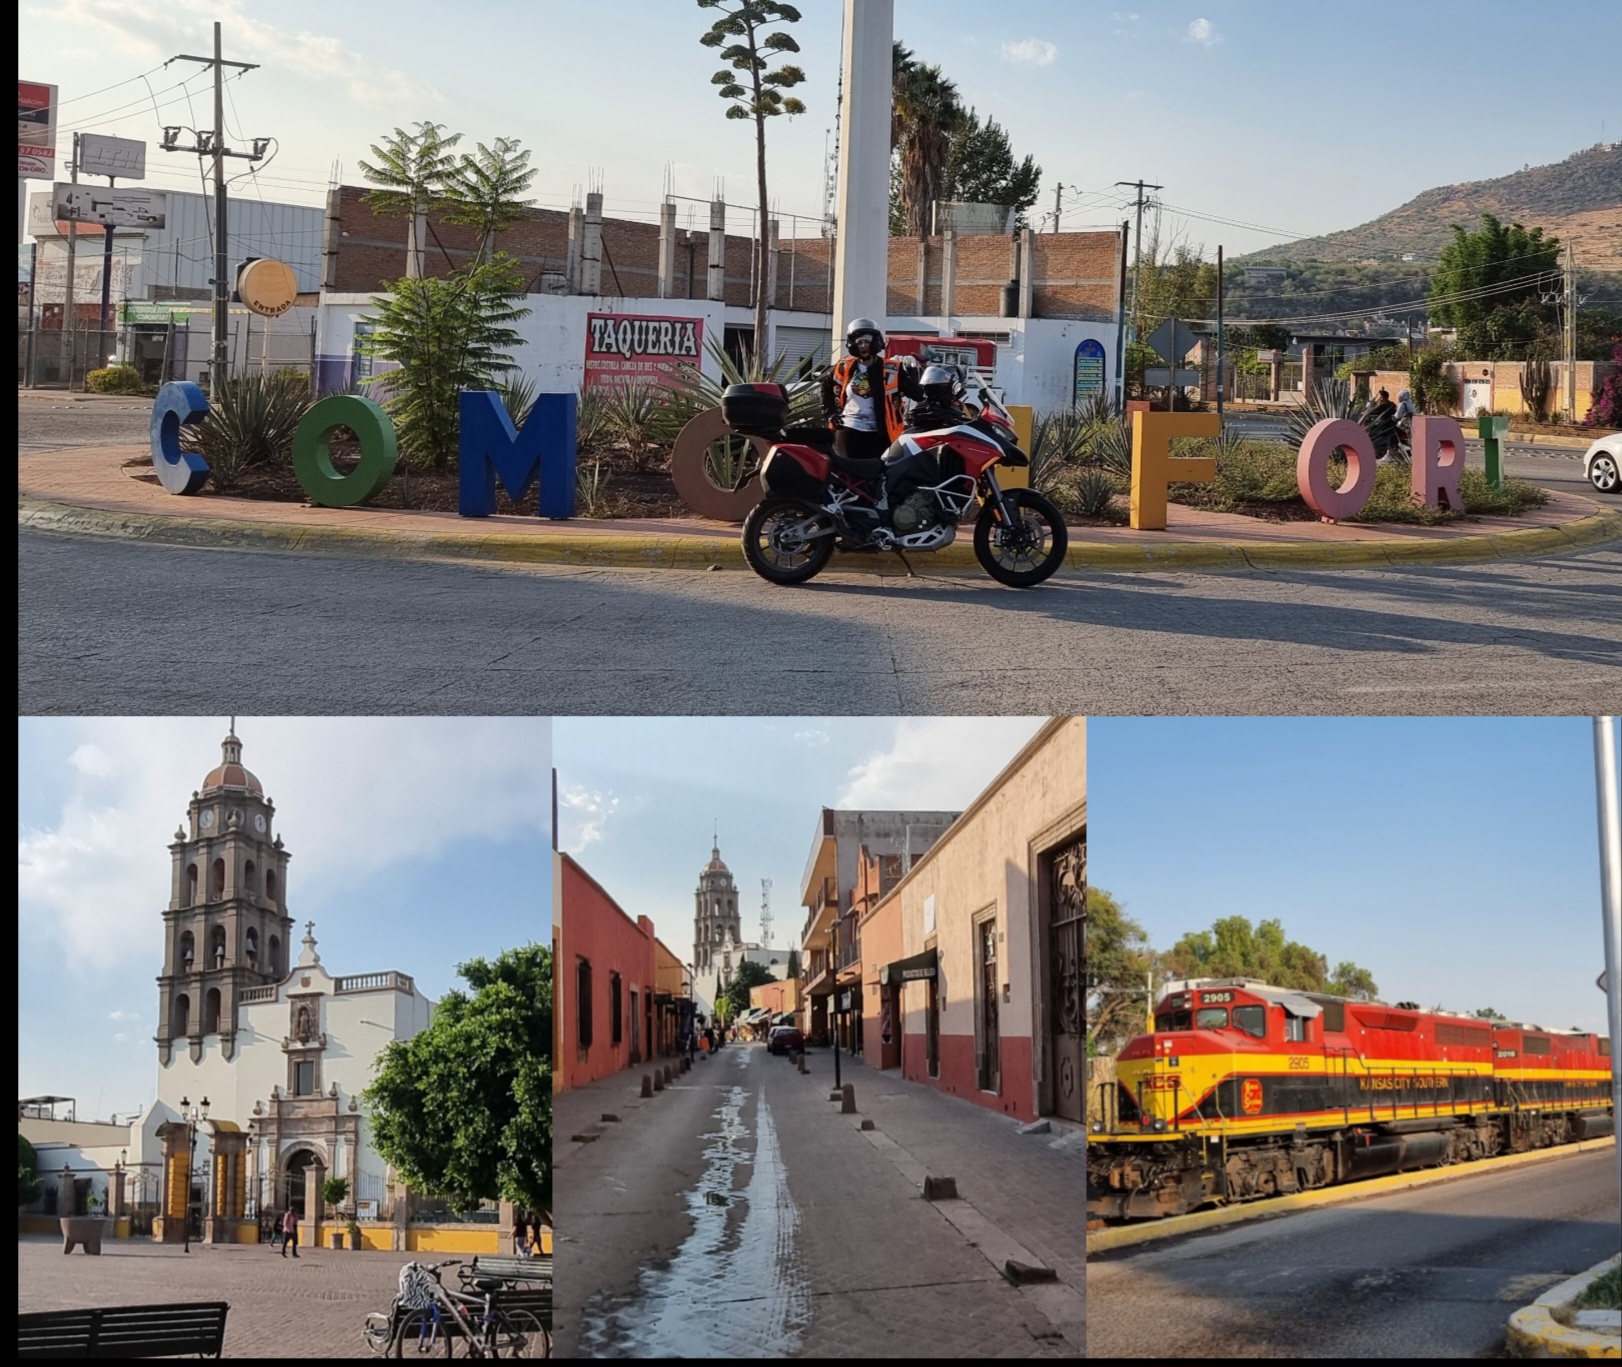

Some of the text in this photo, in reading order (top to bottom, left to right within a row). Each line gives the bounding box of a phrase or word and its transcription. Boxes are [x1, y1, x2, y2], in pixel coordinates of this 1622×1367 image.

[253, 300, 291, 314] ENTRADA
[590, 318, 697, 359] TAQUERIA
[1203, 992, 1231, 1004] 2905
[1288, 1056, 1310, 1070] 2905
[1144, 1075, 1182, 1090] KCS
[1394, 1077, 1410, 1089] CITY
